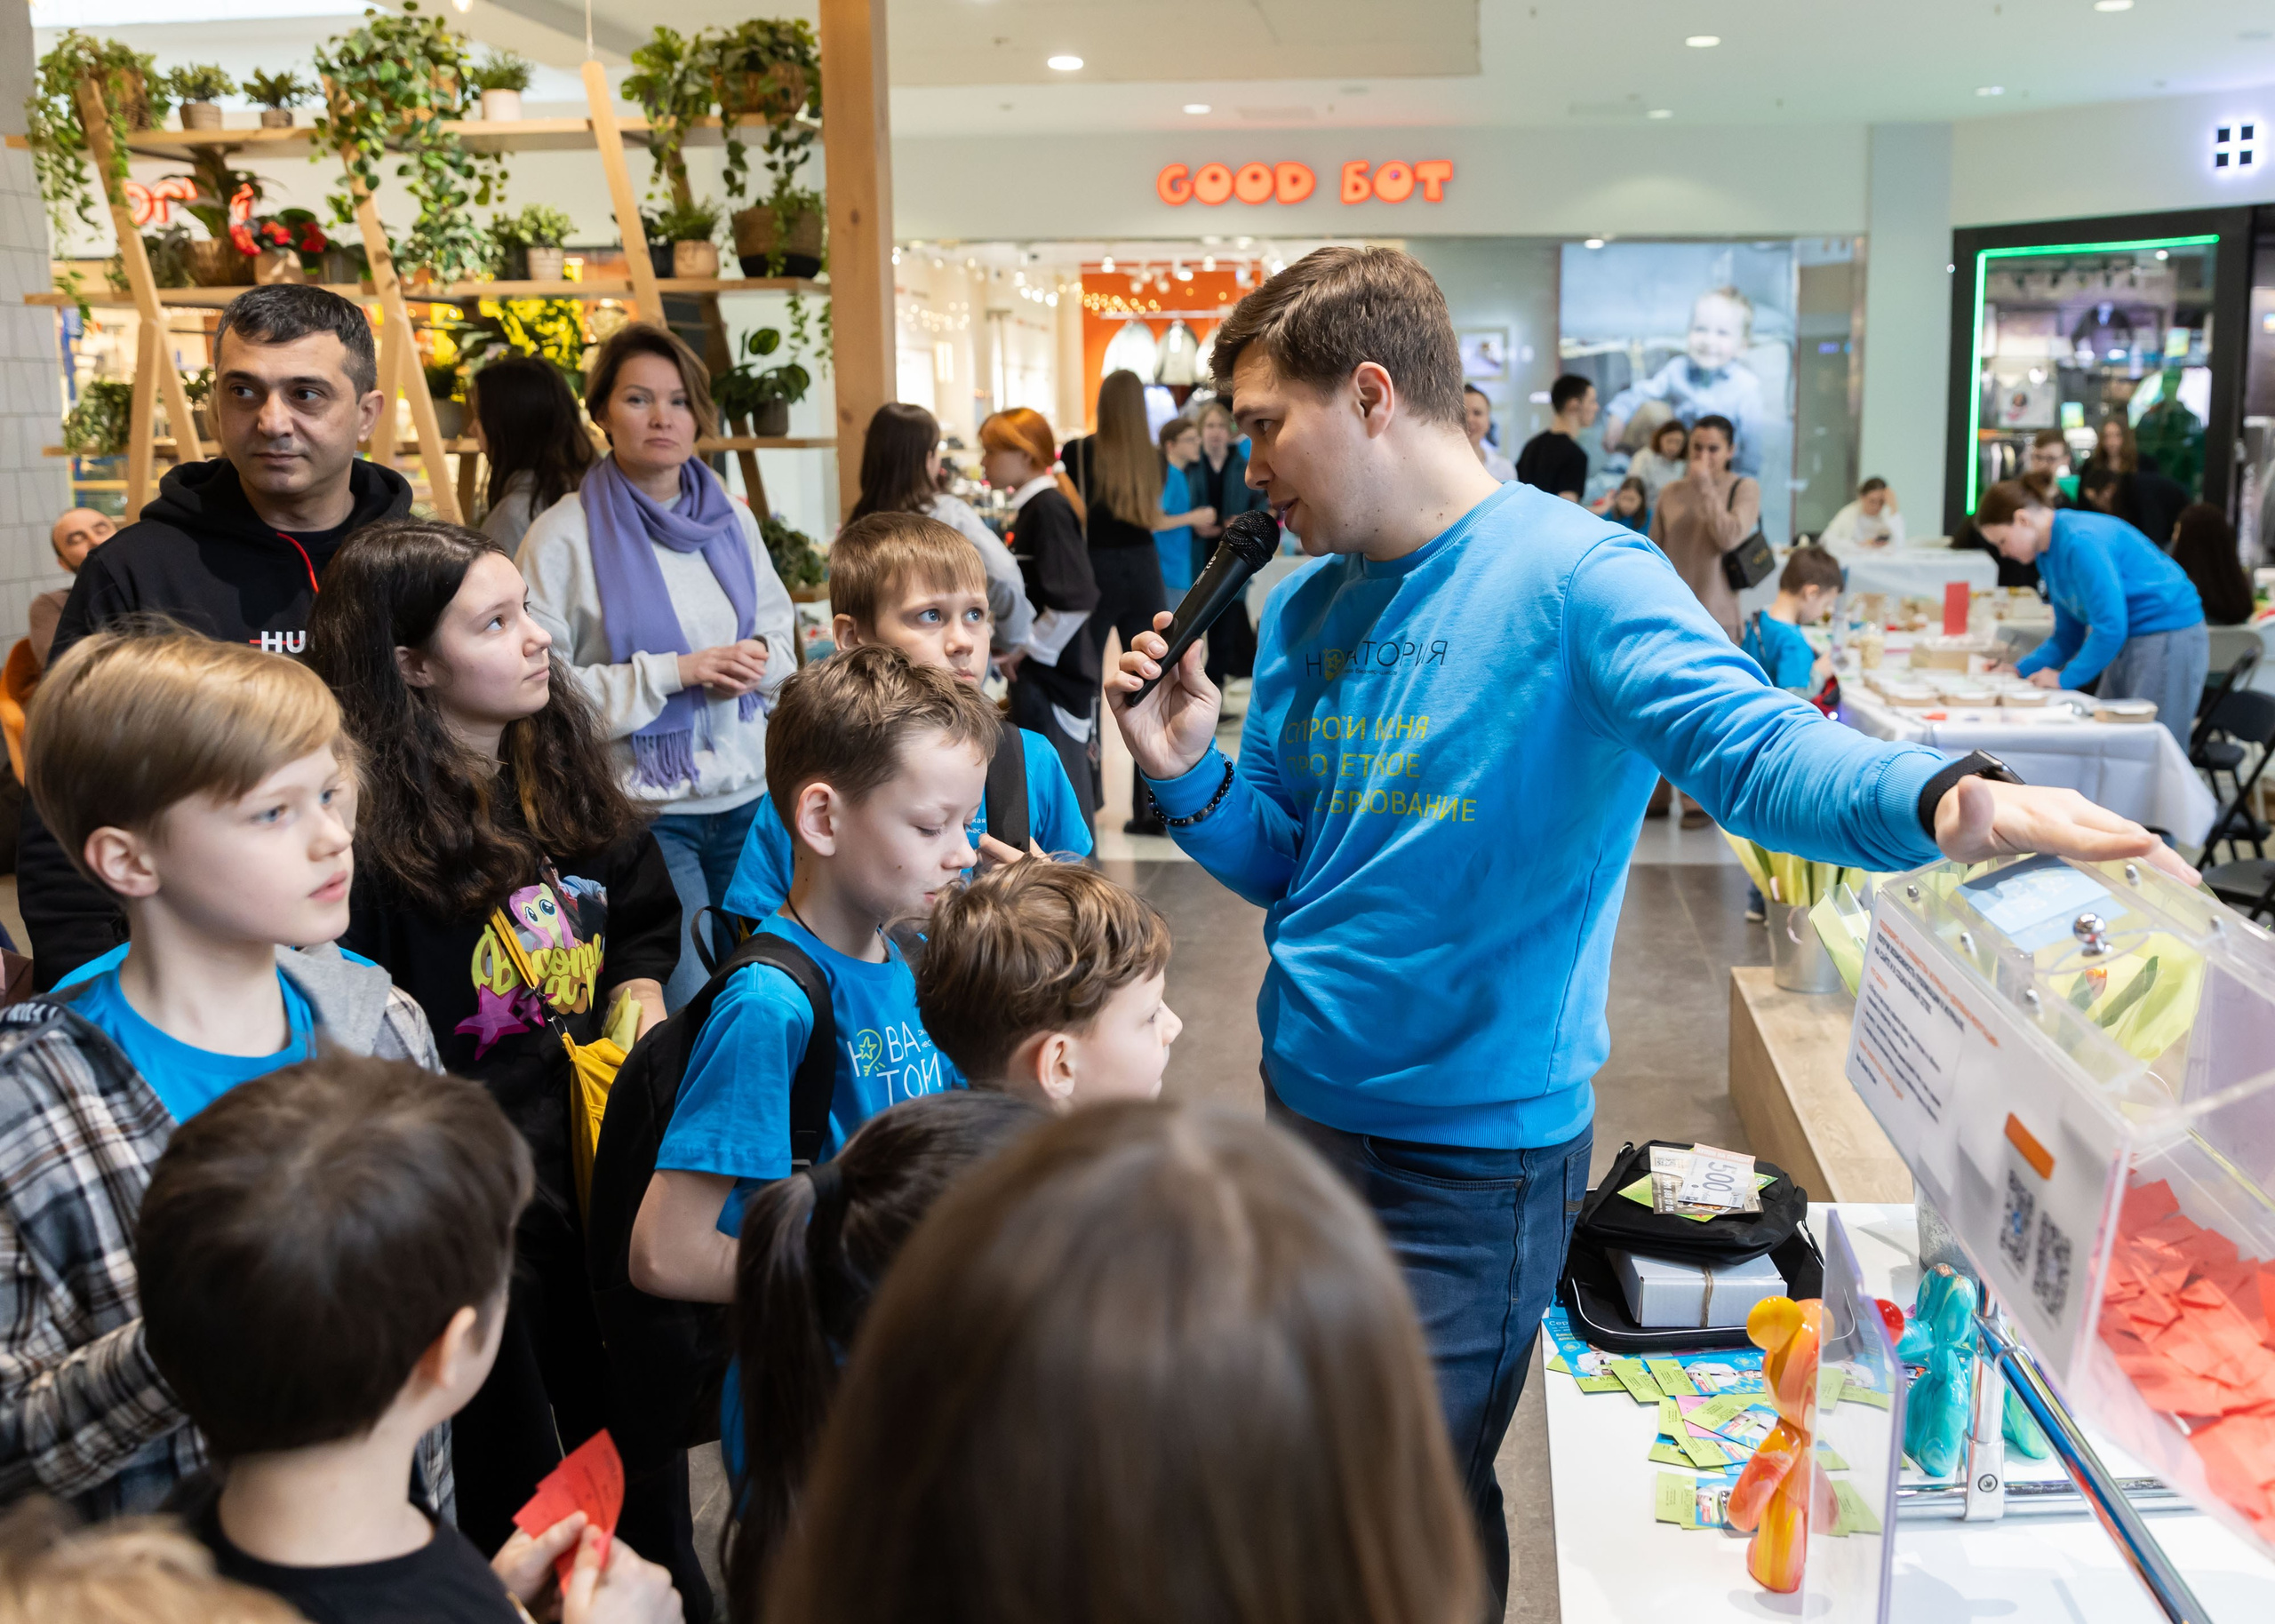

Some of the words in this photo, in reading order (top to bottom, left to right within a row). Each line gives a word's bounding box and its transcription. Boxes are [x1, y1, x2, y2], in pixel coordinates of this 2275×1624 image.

[1156, 161, 1317, 206] GOOD
[1340, 158, 1454, 205] БОТ
[1285, 714, 1366, 744] СПРОИ
[1375, 715, 1430, 741] МНЯ
[1703, 1161, 1736, 1191] 500
